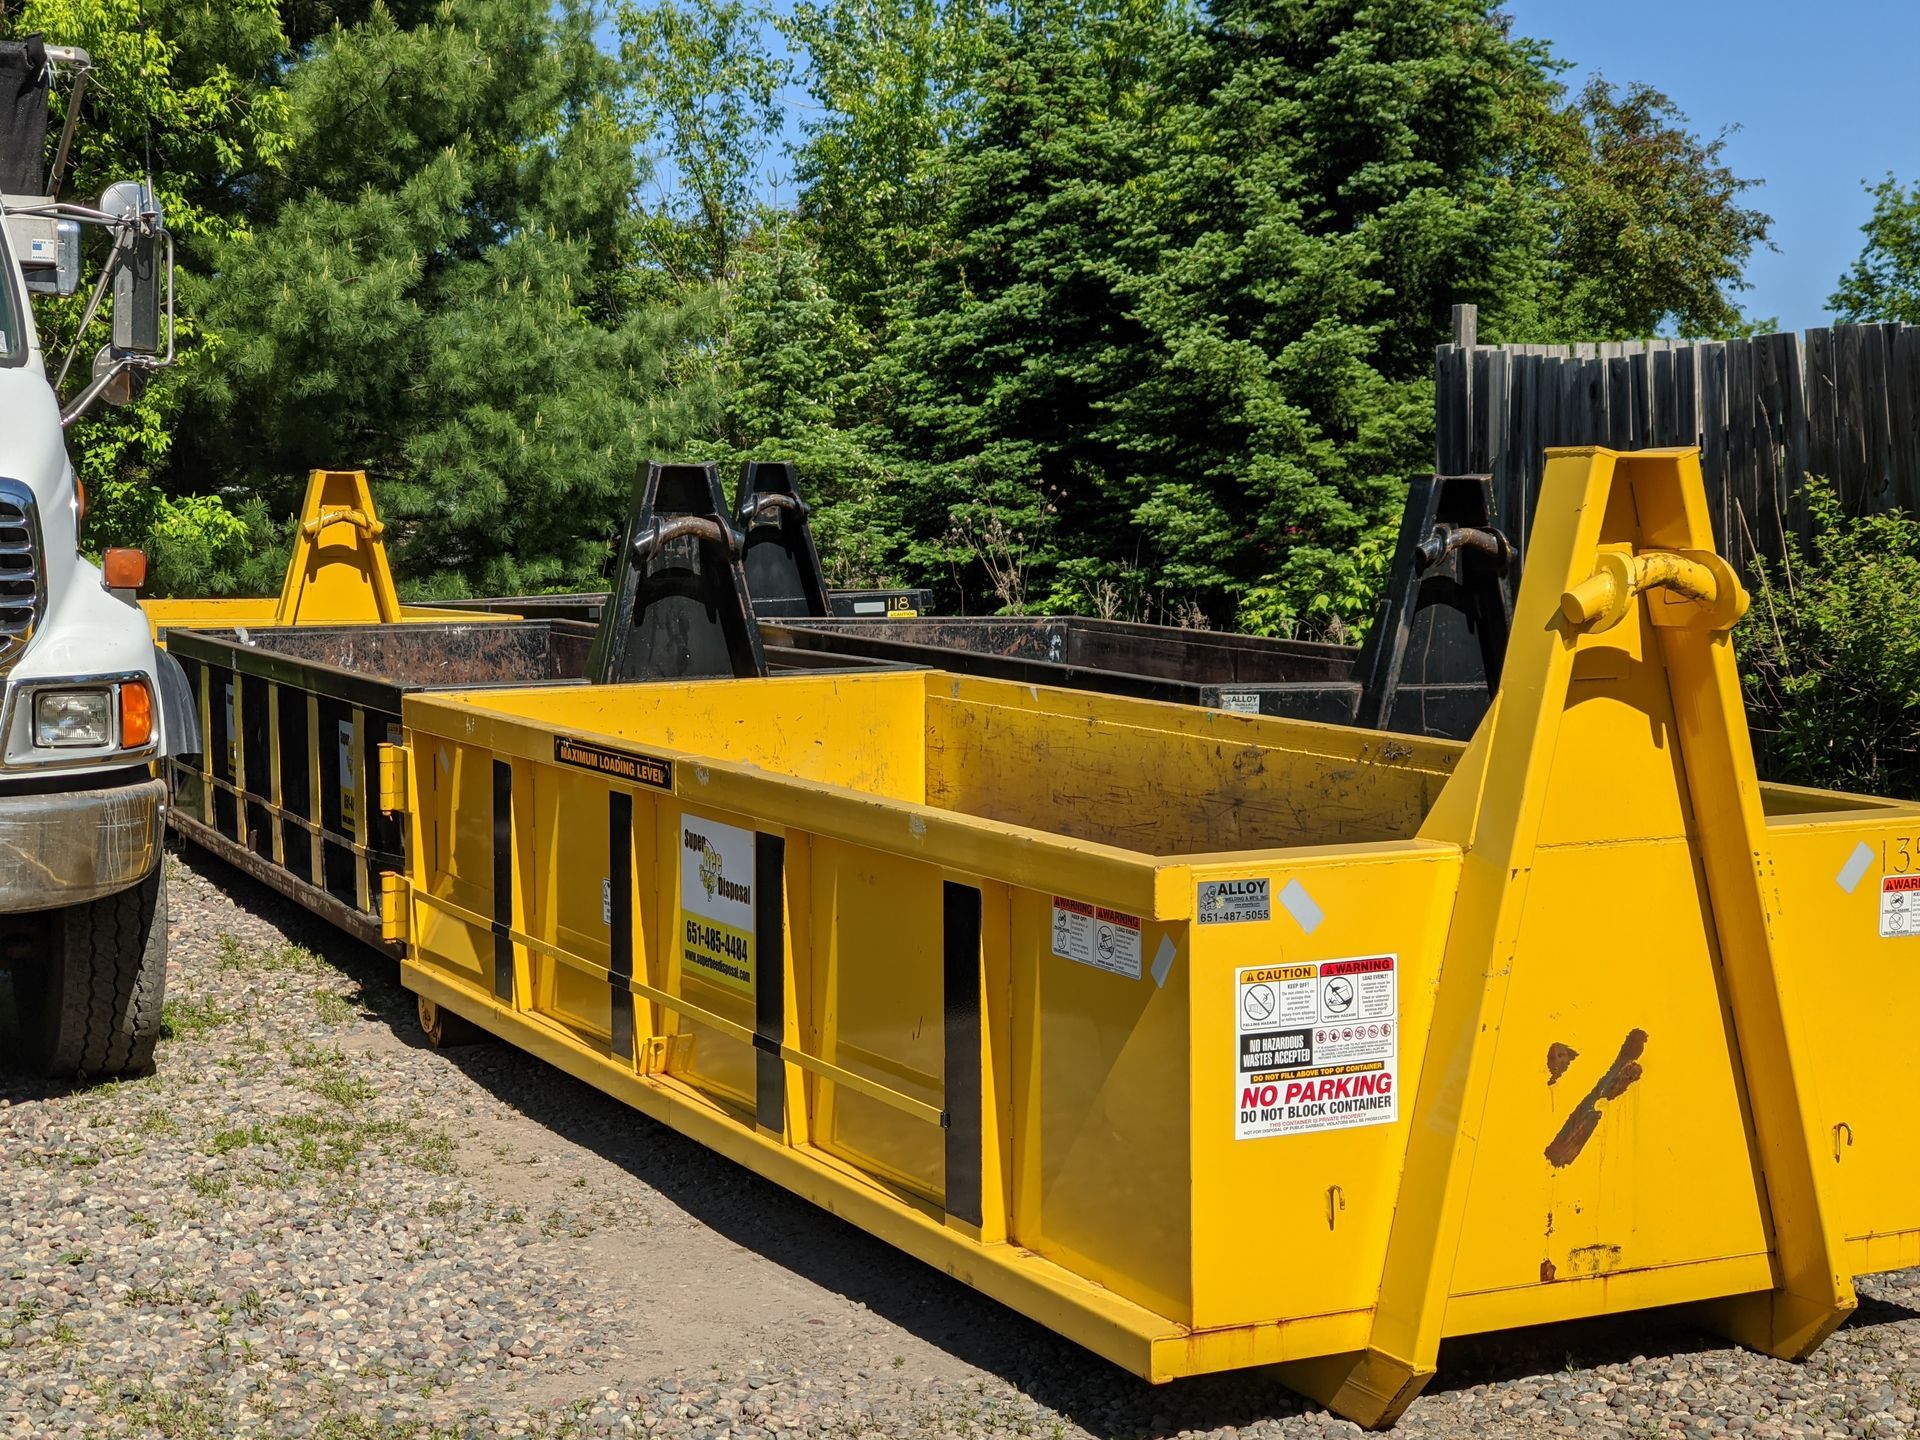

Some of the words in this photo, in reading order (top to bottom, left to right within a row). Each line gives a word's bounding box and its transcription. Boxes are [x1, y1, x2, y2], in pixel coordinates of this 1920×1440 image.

[888, 596, 909, 610] 118
[560, 746, 598, 768] MAXIMUM
[599, 755, 636, 777] LOADING
[637, 764, 664, 784] LEVEL
[684, 828, 706, 852] Super
[703, 846, 722, 875] Bee
[717, 876, 751, 905] Disposal
[1217, 881, 1267, 896] ALLOY
[1059, 896, 1093, 915] WARNING
[1101, 907, 1139, 927] WARNING
[1200, 910, 1269, 922] 651-487-5055
[686, 920, 748, 963] 651-485-4484
[1256, 967, 1311, 981] CAUTION
[1336, 960, 1390, 973] WARNING
[1249, 1039, 1260, 1053] NO
[1262, 1035, 1304, 1051] HAZARDOUS
[1243, 1053, 1273, 1067] WASTES
[1274, 1049, 1310, 1065] ACCEPTED
[1265, 1073, 1279, 1081] NOT
[1280, 1072, 1295, 1080] FILL
[1296, 1069, 1318, 1078] ABOVE
[1346, 1062, 1382, 1072] CONTAINER
[1241, 1085, 1278, 1109] NO
[1284, 1072, 1392, 1105] PARKING
[1241, 1110, 1257, 1124] DO
[1261, 1107, 1284, 1121] NOT
[1288, 1103, 1326, 1119] BLOCK
[1330, 1095, 1391, 1114] CONTAINER
[1282, 1118, 1312, 1126] CONTAINER
[1319, 1115, 1339, 1123] PRIVATE
[1340, 1112, 1367, 1120] PROPERTY
